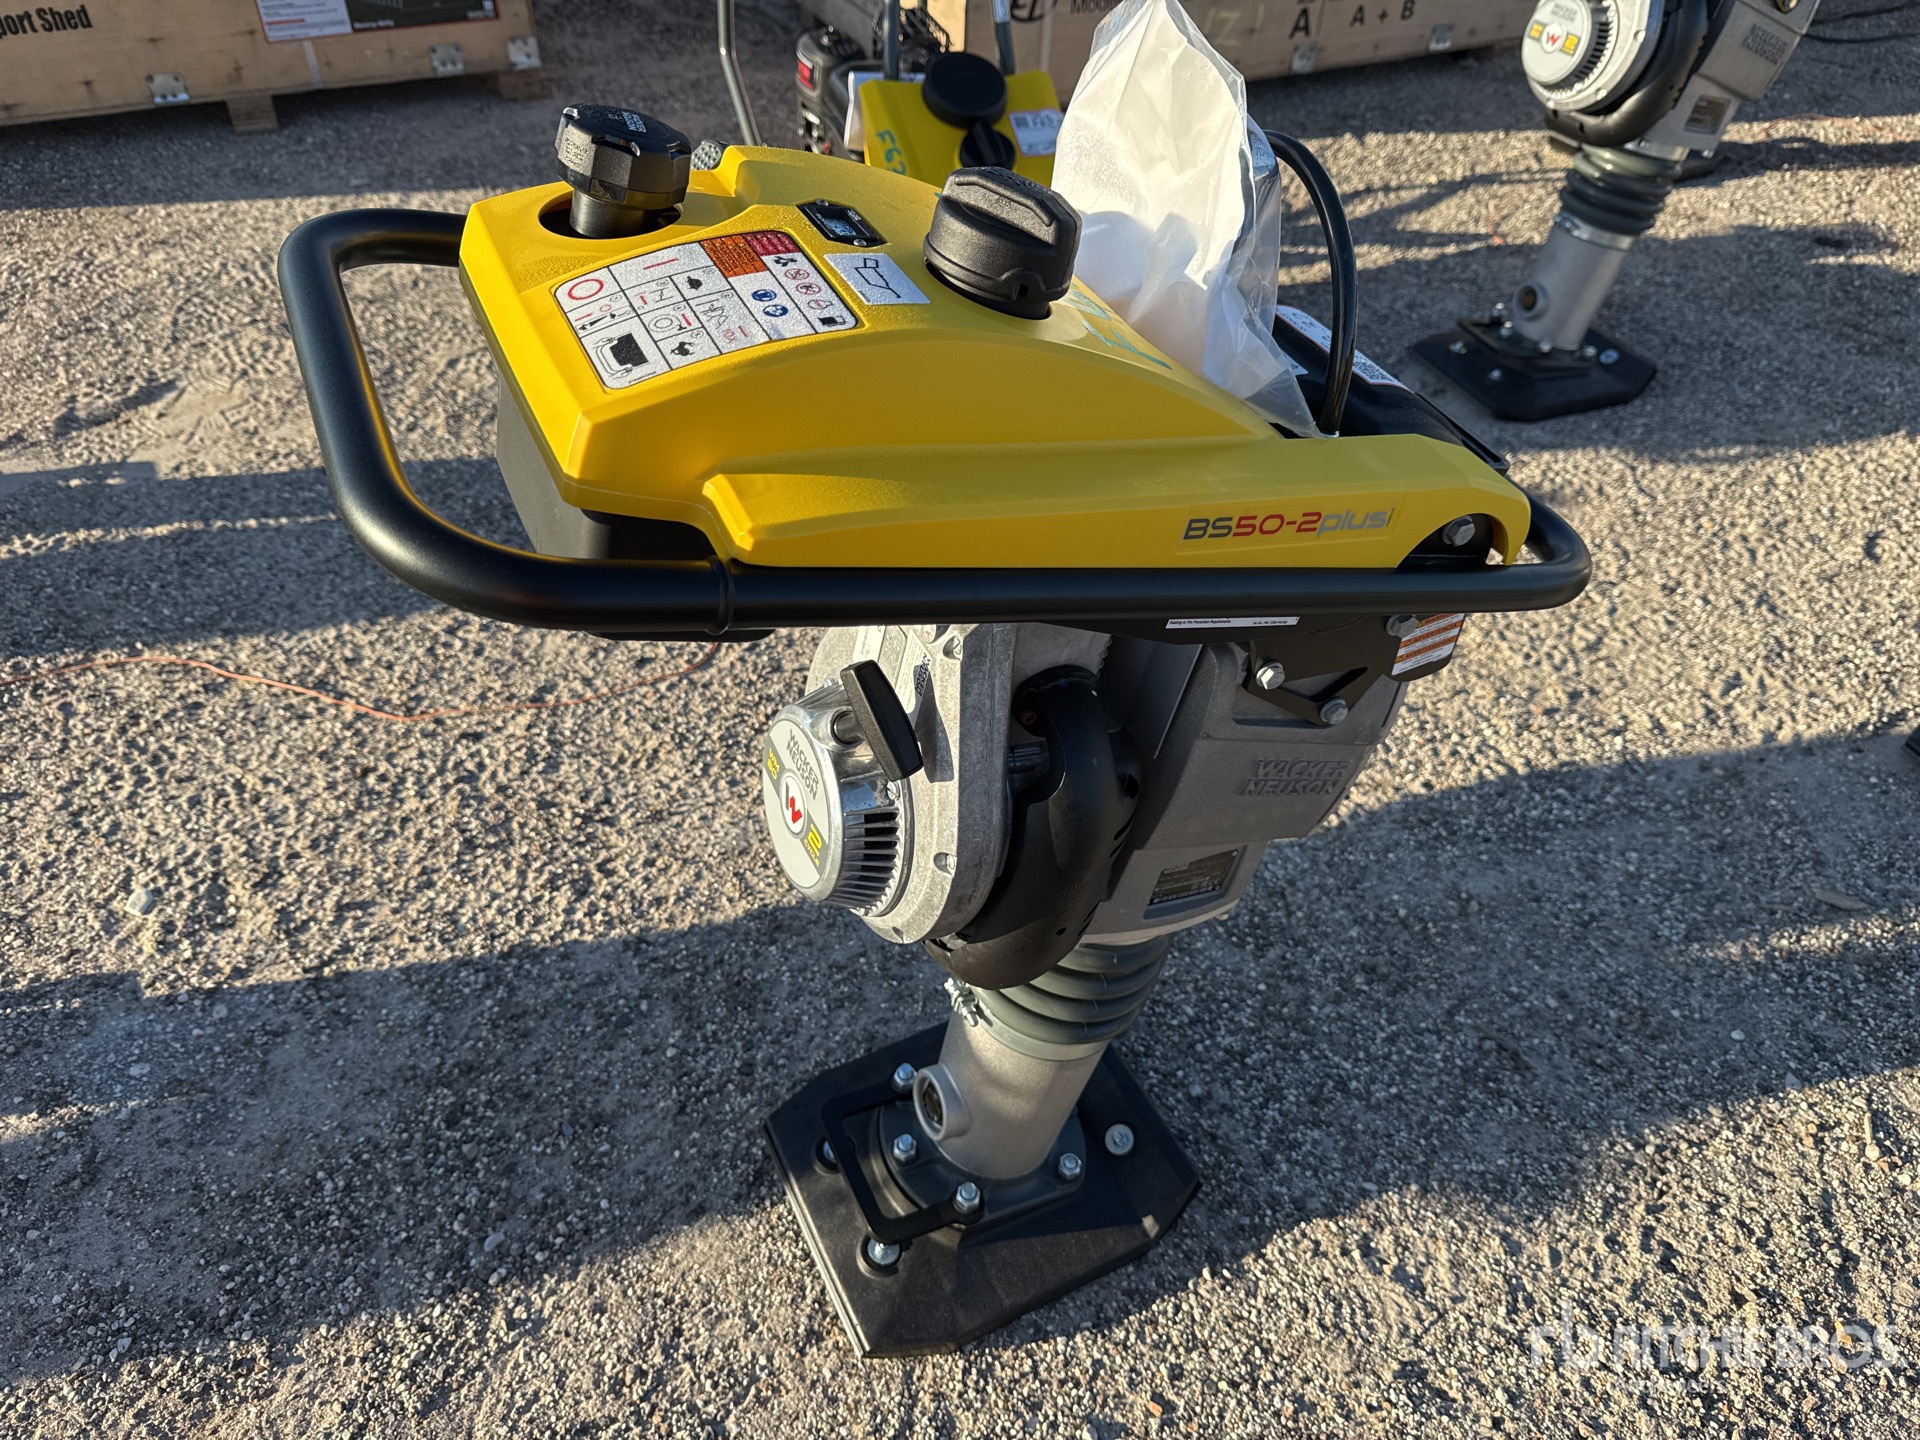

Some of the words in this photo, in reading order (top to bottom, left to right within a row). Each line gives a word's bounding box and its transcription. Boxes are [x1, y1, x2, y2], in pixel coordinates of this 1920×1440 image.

[35, 4, 92, 32] Shed
[1289, 7, 1311, 40] A
[1350, 5, 1365, 27] A
[1400, 0, 1415, 20] B
[1183, 508, 1388, 541] BS50-2plus
[786, 740, 818, 801] NEUSON
[789, 728, 820, 786] WACKER
[1257, 759, 1350, 779] WACKER
[1238, 778, 1337, 796] NEUSON
